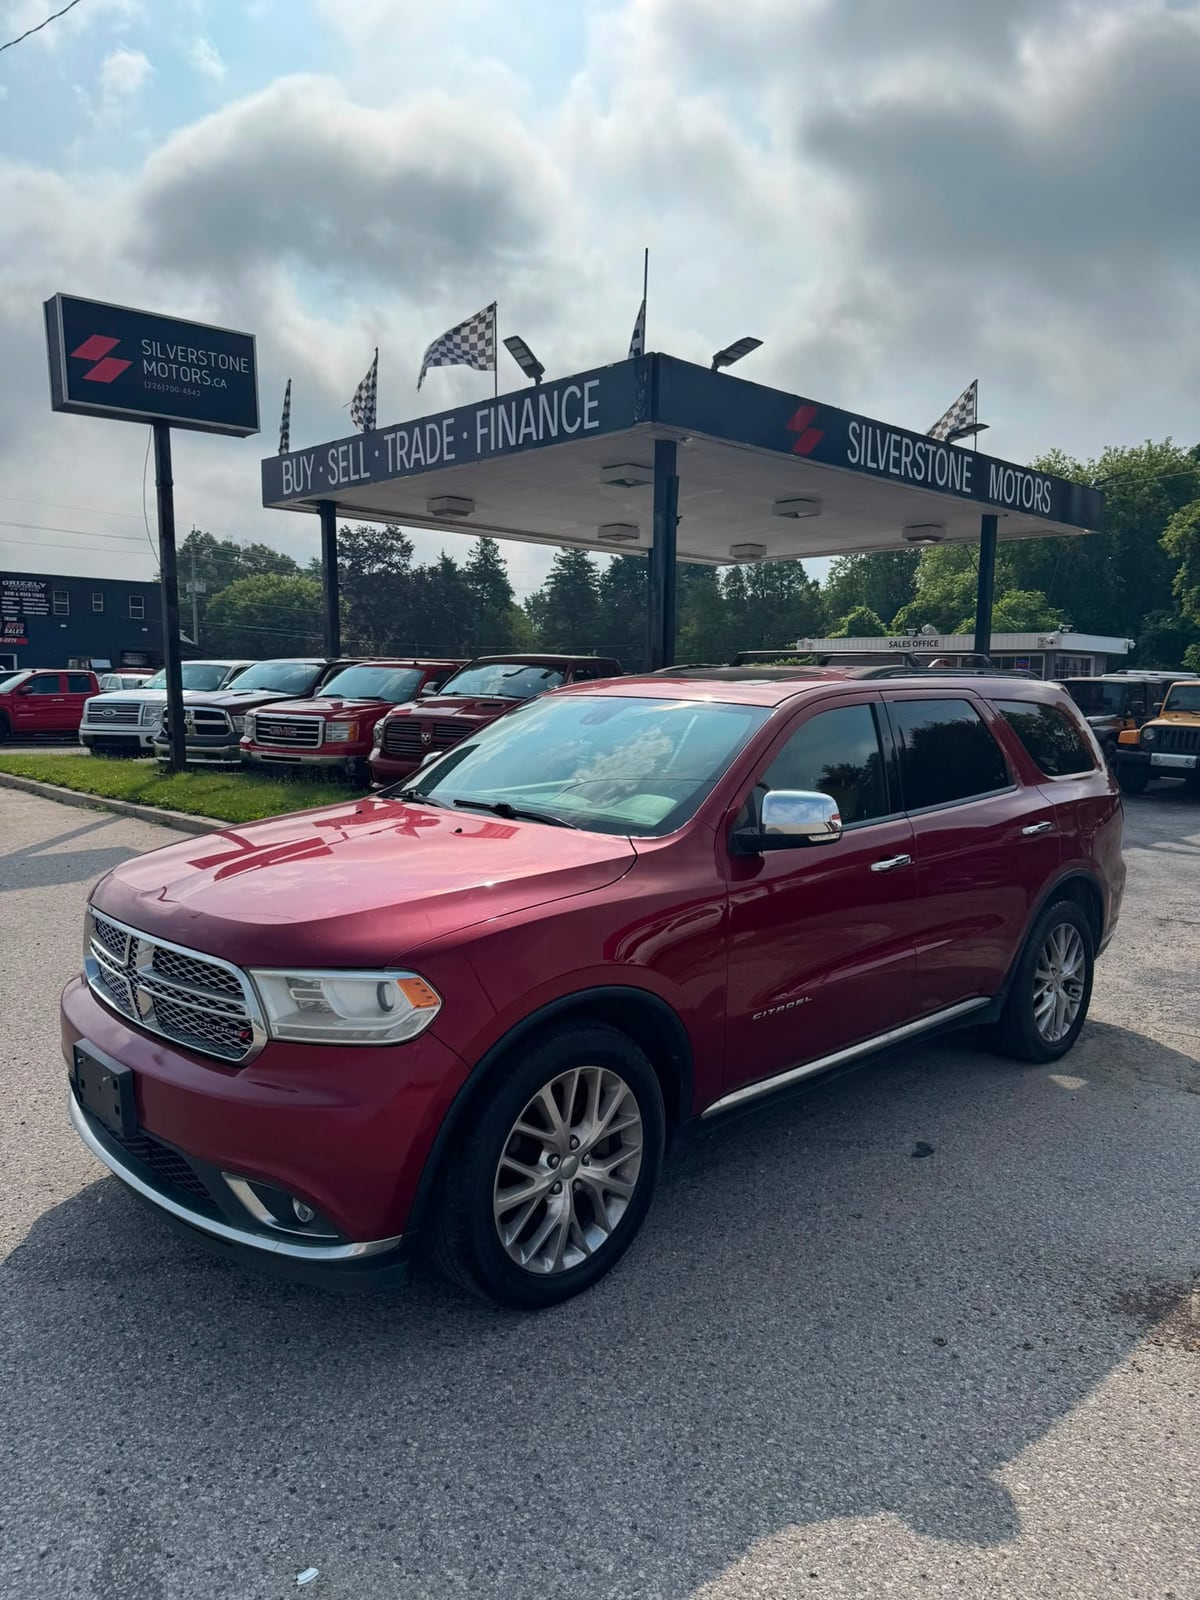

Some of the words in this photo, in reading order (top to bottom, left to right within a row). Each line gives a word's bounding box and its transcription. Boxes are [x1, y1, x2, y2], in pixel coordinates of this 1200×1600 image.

[141, 339, 249, 374] SILVERSTONE
[143, 359, 227, 389] MOTORS.CA
[282, 453, 316, 496] BUY
[327, 441, 371, 486] SELL
[383, 417, 456, 473] TRADE
[475, 379, 600, 454] FINANCE
[847, 421, 973, 494] SILVERSTONE
[988, 463, 1052, 514] MOTORS
[2, 580, 47, 589] GRIZZLY
[888, 640, 911, 649] SALES
[912, 639, 939, 648] OFFICE
[752, 996, 813, 1021] CITADEL
